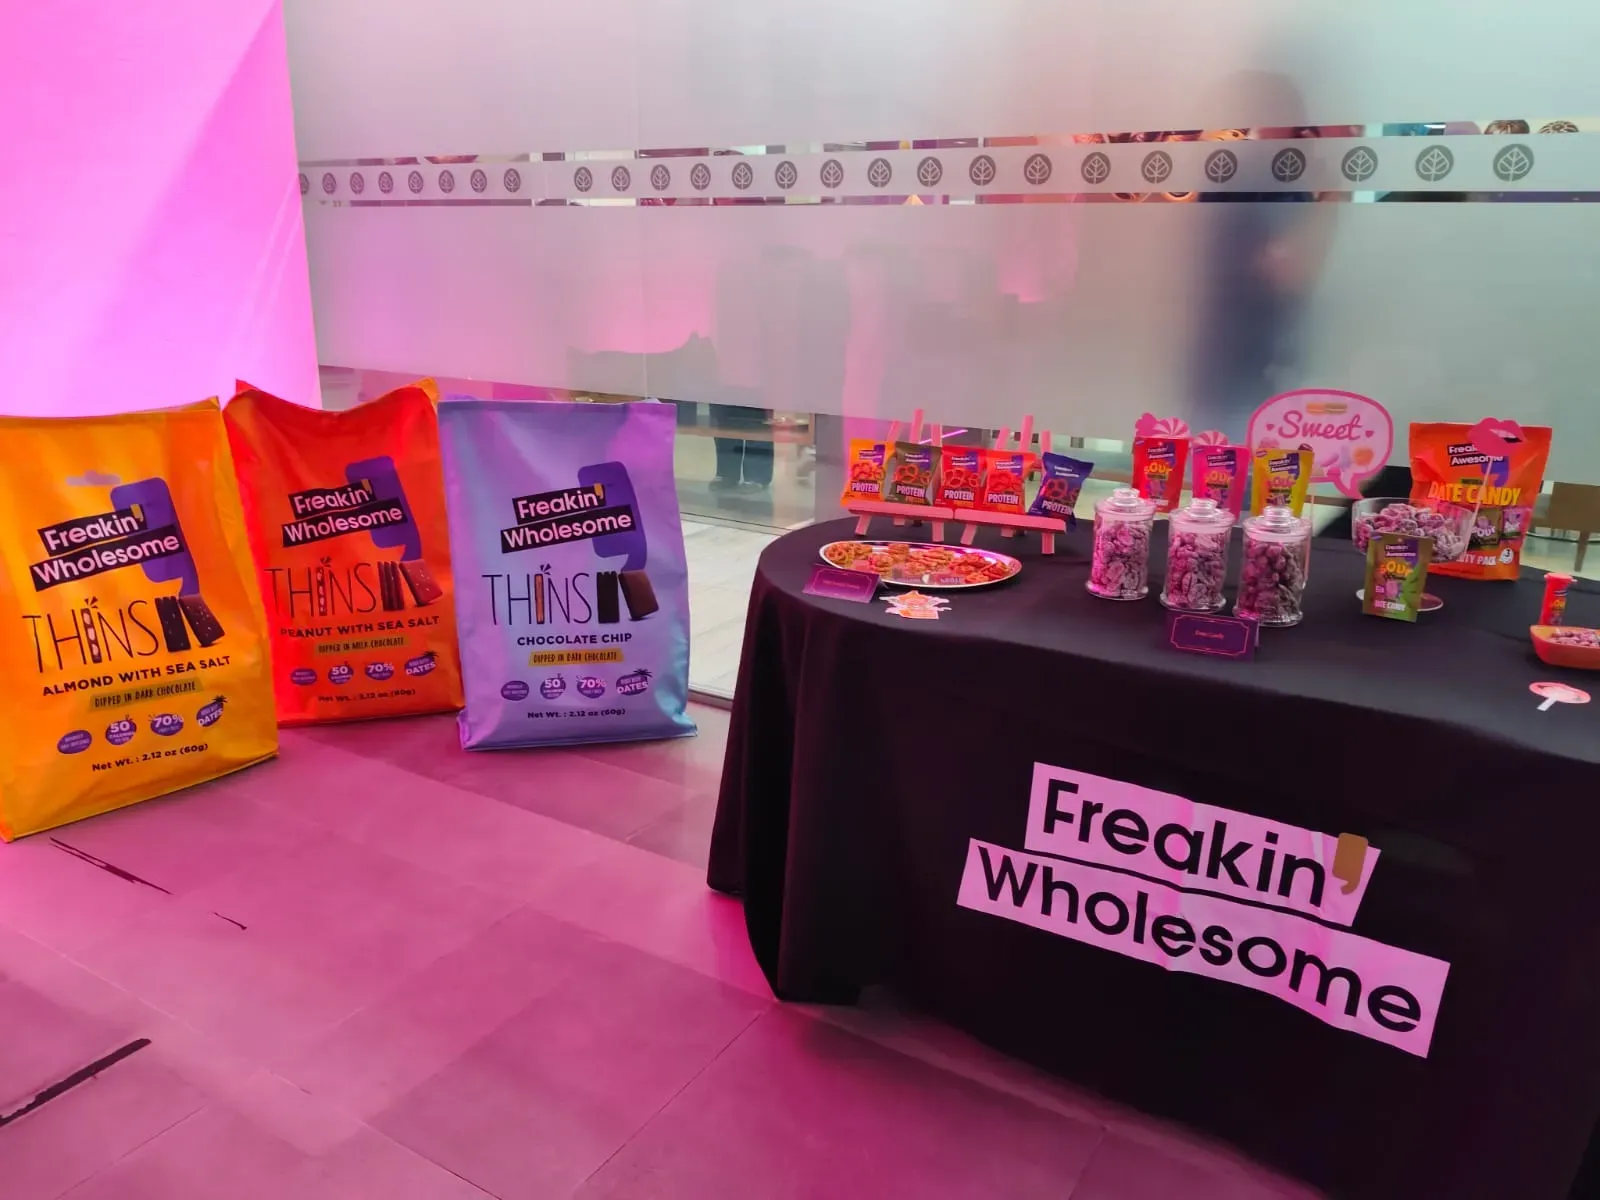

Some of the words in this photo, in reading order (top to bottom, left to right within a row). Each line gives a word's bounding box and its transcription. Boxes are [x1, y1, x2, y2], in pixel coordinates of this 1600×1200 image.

[1278, 410, 1362, 440] Sweet
[293, 479, 373, 514] Freakin'
[852, 483, 880, 493] PROTEIN
[896, 485, 926, 498] PROTEIN
[944, 489, 974, 501] PROTEIN
[1428, 480, 1463, 502] DATE
[1466, 485, 1521, 506] CANDY
[517, 482, 604, 519] Freakin'
[988, 493, 1019, 505] PROTEIN
[1042, 500, 1073, 515] PROTEIN
[44, 504, 144, 551] Freakin'
[284, 507, 402, 542] Wholesome
[503, 514, 632, 548] Wholesome
[33, 535, 180, 583] Wholesome
[264, 560, 376, 619] THINS
[482, 571, 593, 625] THINS
[22, 599, 159, 673] THINS
[280, 627, 333, 638] PEANUT
[337, 624, 373, 635] WITH
[378, 620, 404, 631] SEA
[408, 616, 440, 627] SALT
[370, 637, 404, 648] CHOCOLATE
[517, 635, 598, 646] CHOCOLATE
[601, 633, 633, 643] CHIP
[533, 653, 555, 663] DIPPED
[557, 653, 565, 662] IN
[584, 651, 617, 661] CHOCOLATE
[43, 675, 114, 697] ALMOND
[118, 667, 161, 683] WITH
[166, 661, 196, 675] SEA
[200, 655, 231, 669] SALT
[331, 666, 348, 675] 50
[367, 661, 394, 673] 70%
[405, 661, 436, 675] DATES
[544, 679, 561, 688] 50
[580, 679, 608, 688] 70%
[616, 681, 649, 694] DATES
[95, 693, 122, 708] DIPPED
[123, 692, 132, 702] IN
[156, 681, 196, 696] CHOCOLATE
[154, 714, 184, 728] 70%
[197, 708, 223, 726] DATES
[527, 711, 544, 719] Net
[569, 710, 586, 718] 2.12
[110, 720, 131, 733] 50
[92, 762, 112, 772] Net
[115, 756, 133, 767] Wt.
[142, 751, 162, 762] 2.12
[164, 748, 177, 757] oz
[180, 743, 208, 755] (60g)
[1042, 778, 1369, 907] Freakin'
[977, 845, 1423, 1033] Wholesome
